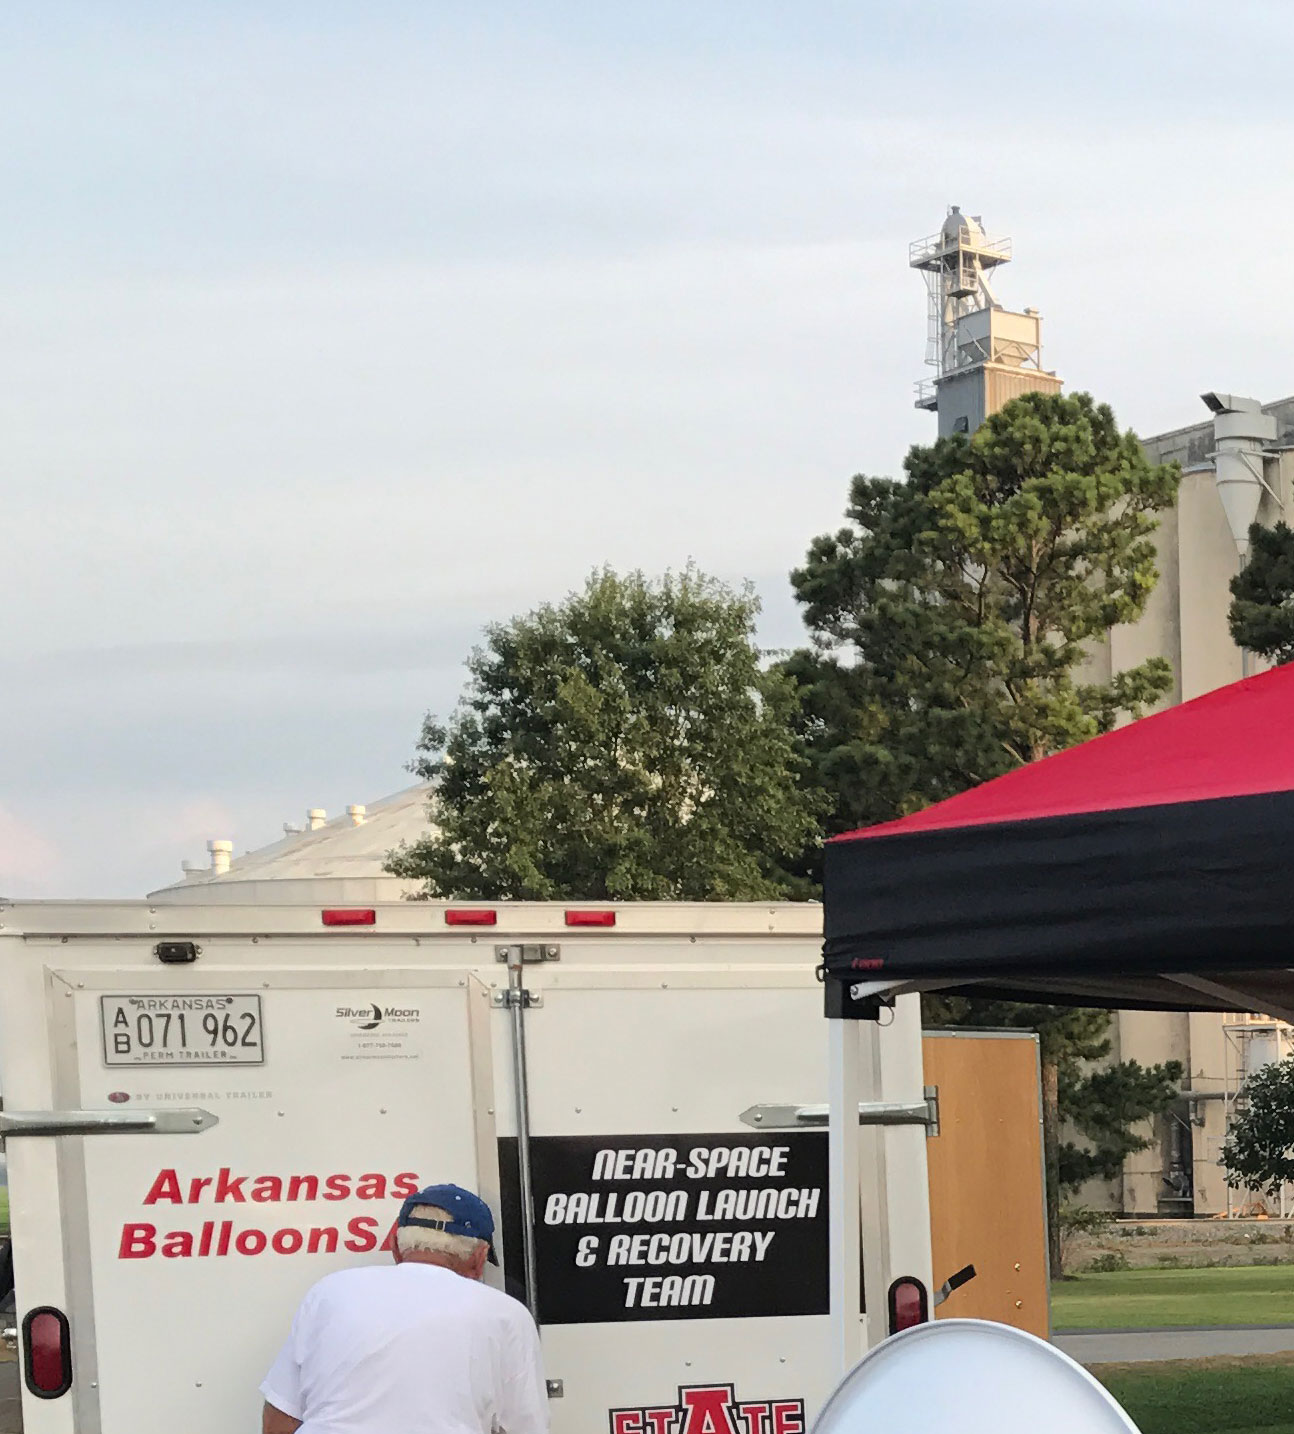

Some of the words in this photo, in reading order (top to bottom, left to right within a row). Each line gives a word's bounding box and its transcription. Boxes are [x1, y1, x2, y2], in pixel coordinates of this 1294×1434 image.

[136, 999, 227, 1010] ARKANSAS
[336, 1007, 374, 1018] Silver
[384, 1007, 420, 1017] Moon
[136, 1013, 187, 1048] 071
[202, 1012, 258, 1047] 962
[143, 1052, 174, 1060] PERM
[179, 1050, 228, 1060] TRAILER
[156, 1091, 221, 1100] UNIVERSAL
[226, 1090, 273, 1099] TRAILER
[592, 1147, 790, 1180] NEAR-SPACE
[143, 1167, 420, 1206] Arkansas
[544, 1191, 688, 1226] BALLOON
[697, 1188, 820, 1221] LAUNCH
[575, 1236, 600, 1267] &
[607, 1231, 775, 1266] RECOVERY
[623, 1274, 716, 1308] TEAM
